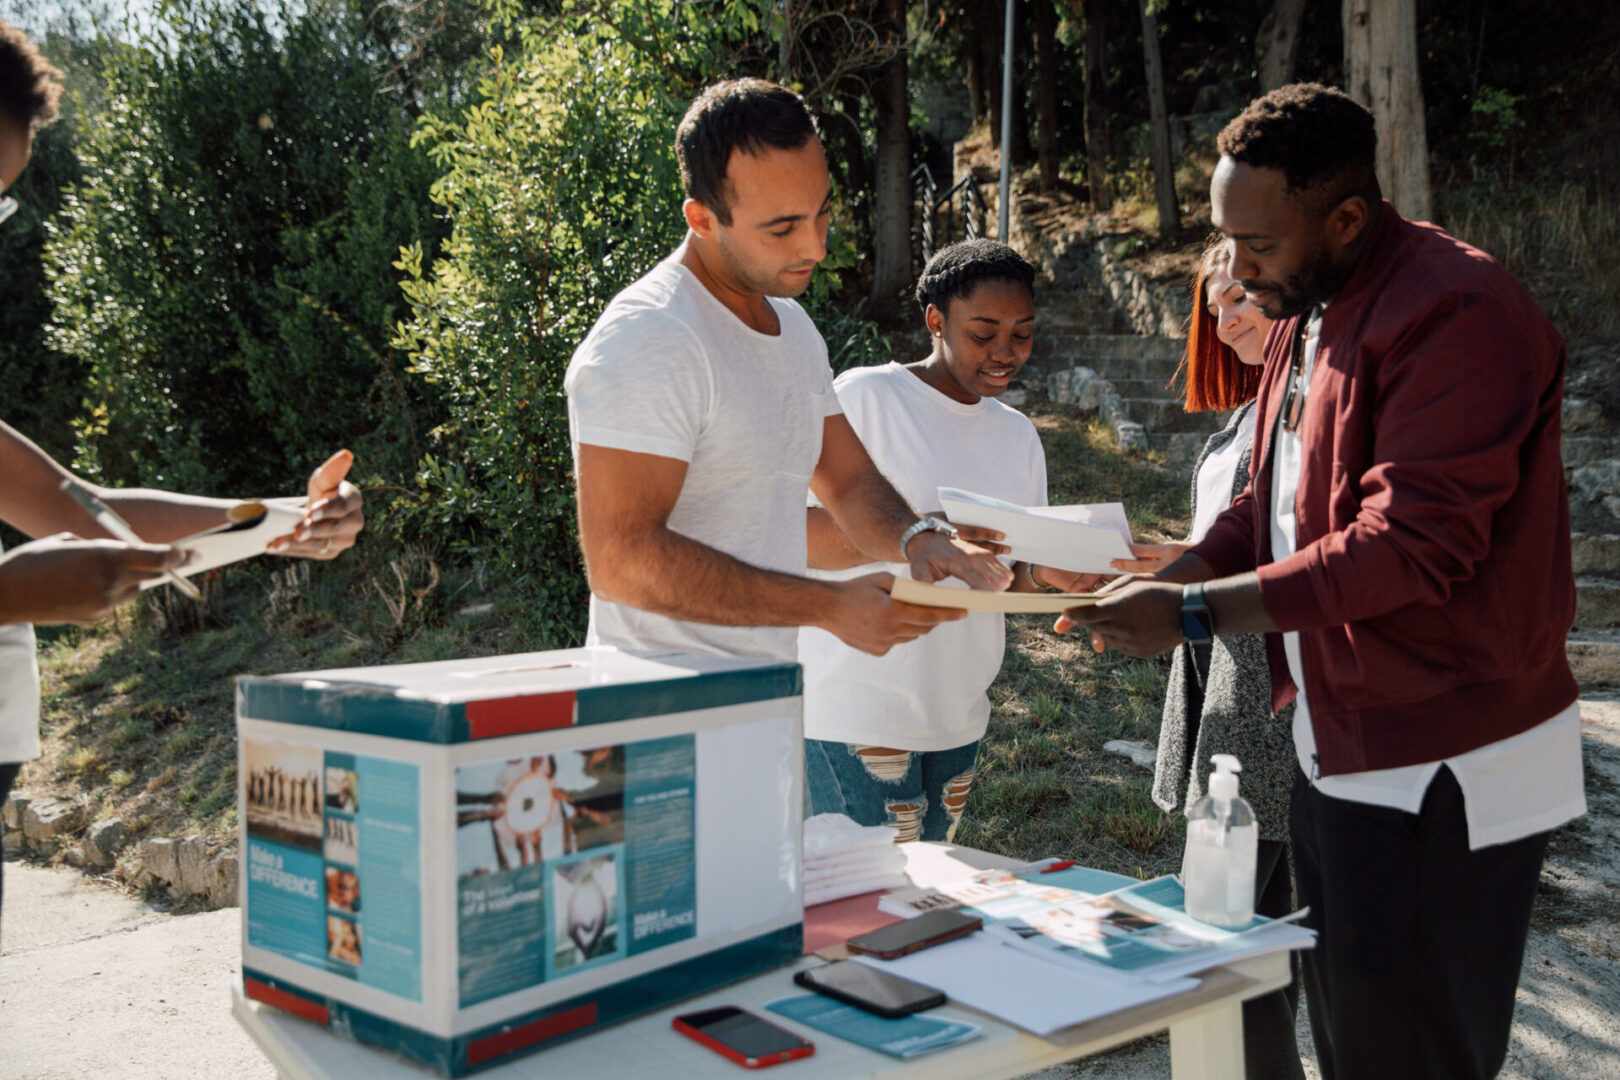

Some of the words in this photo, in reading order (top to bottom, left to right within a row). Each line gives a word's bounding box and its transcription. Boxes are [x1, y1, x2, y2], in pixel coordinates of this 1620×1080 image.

[276, 855, 284, 869] a
[250, 862, 319, 899] DIFFERENCE
[633, 911, 694, 939] DIFFERENCE
